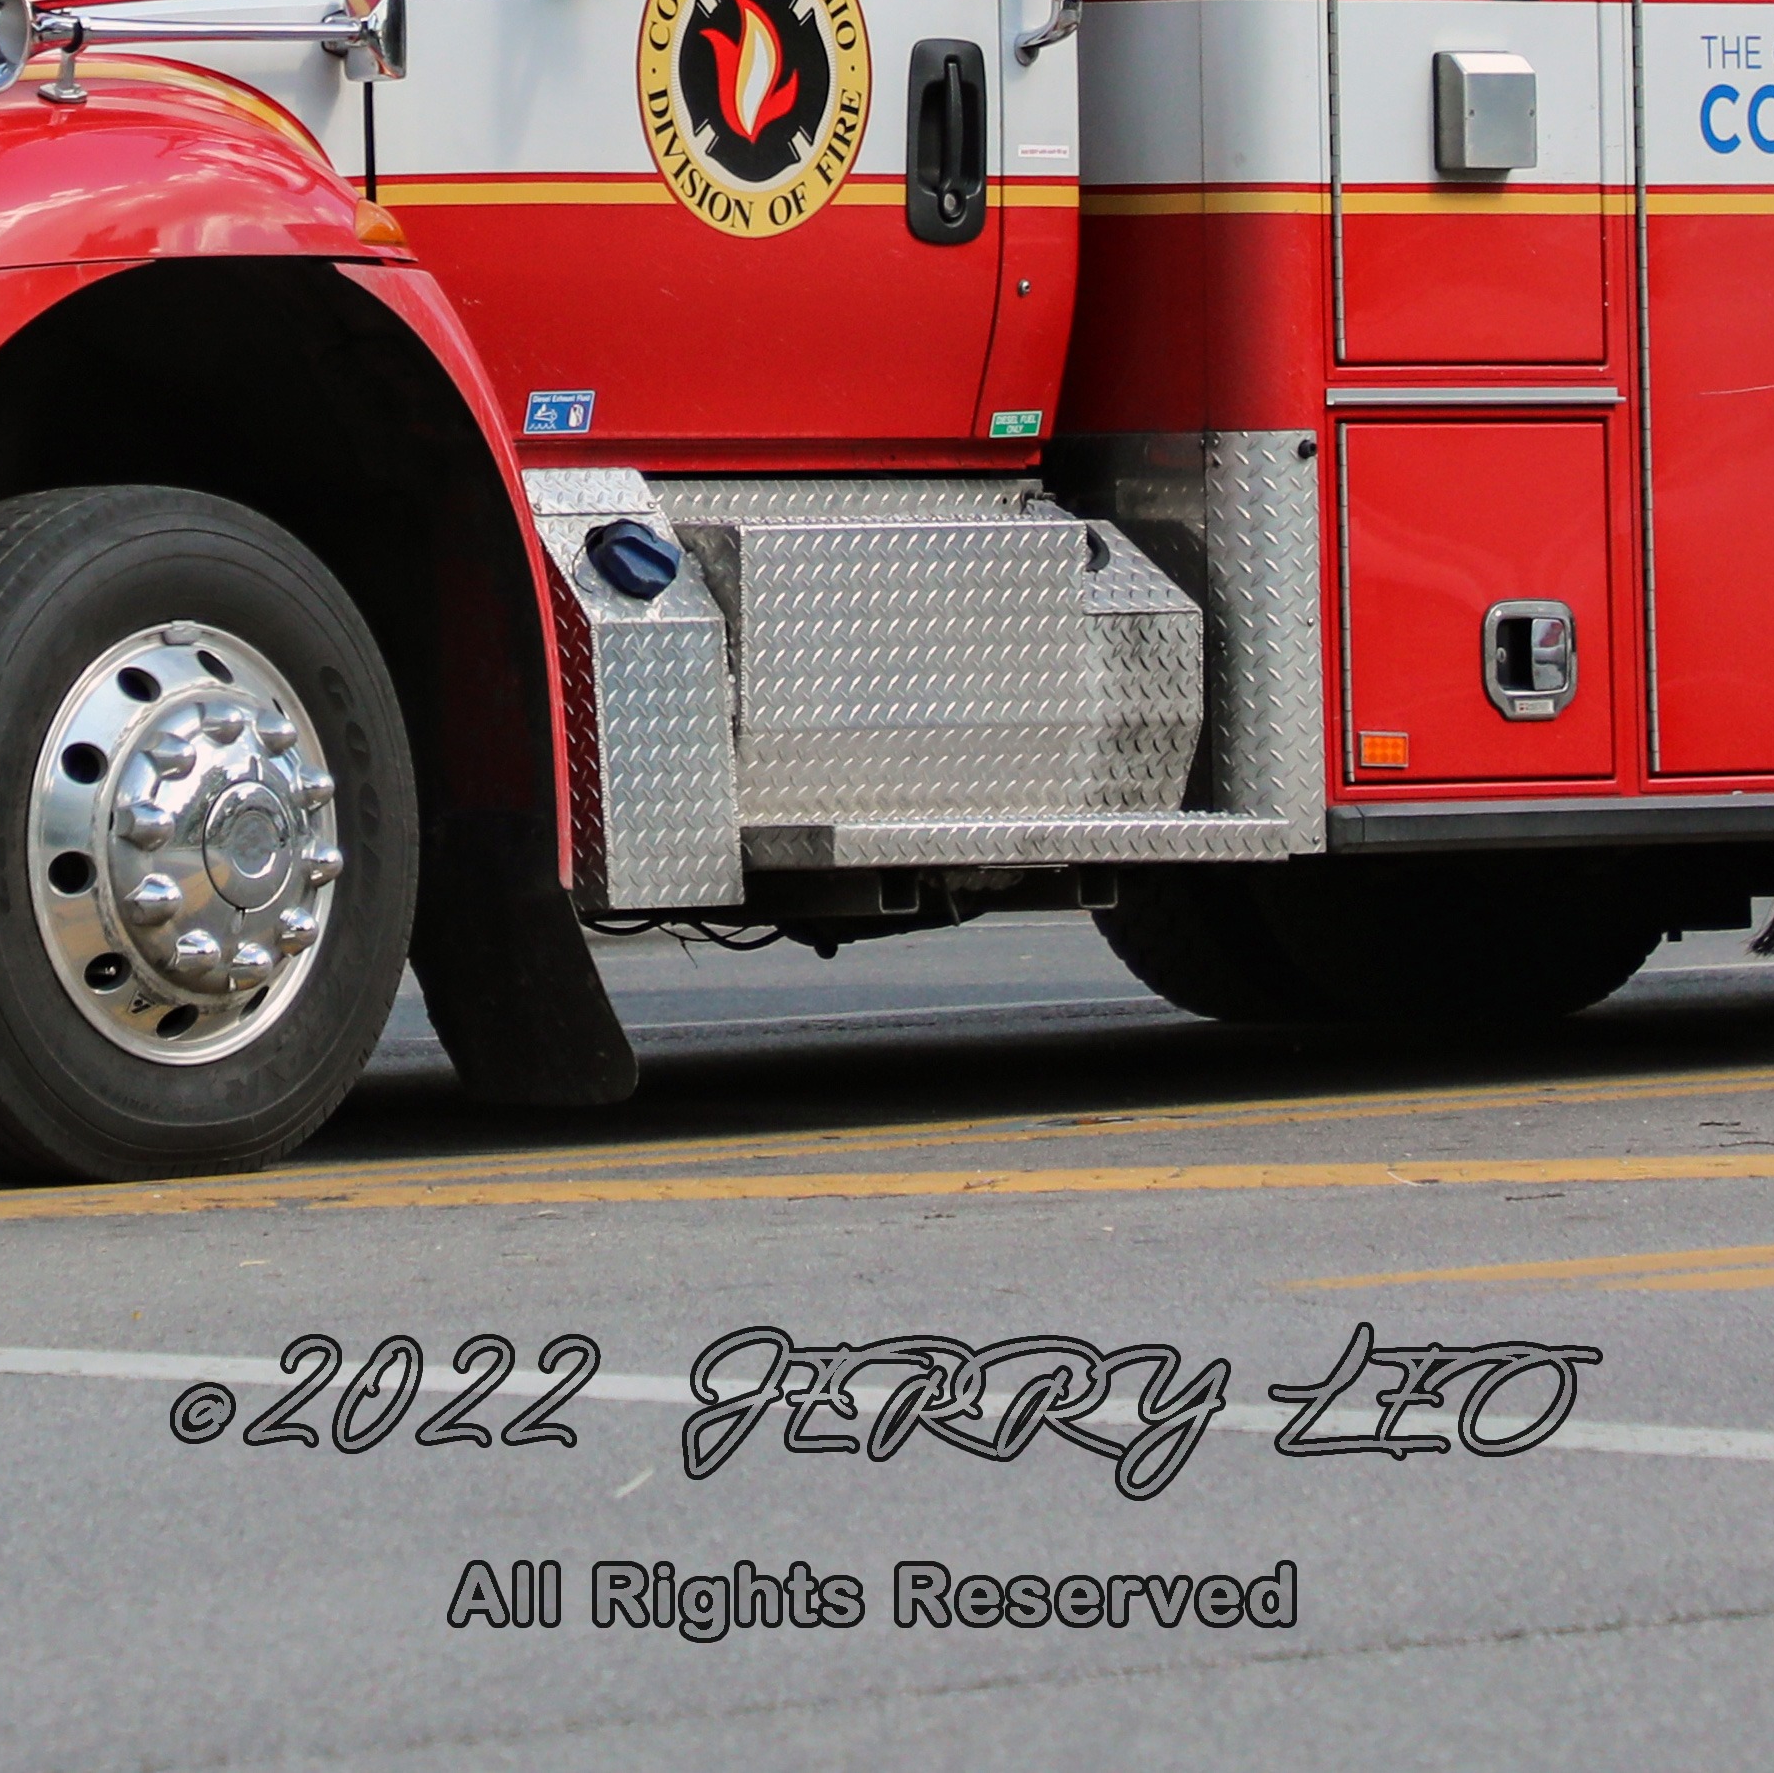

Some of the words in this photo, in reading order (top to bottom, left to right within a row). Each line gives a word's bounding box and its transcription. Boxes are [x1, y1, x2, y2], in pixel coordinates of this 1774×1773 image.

[1700, 35, 1762, 70] THE
[648, 83, 754, 230] DIVISION
[768, 183, 809, 227] OF
[814, 89, 863, 188] FIRE
